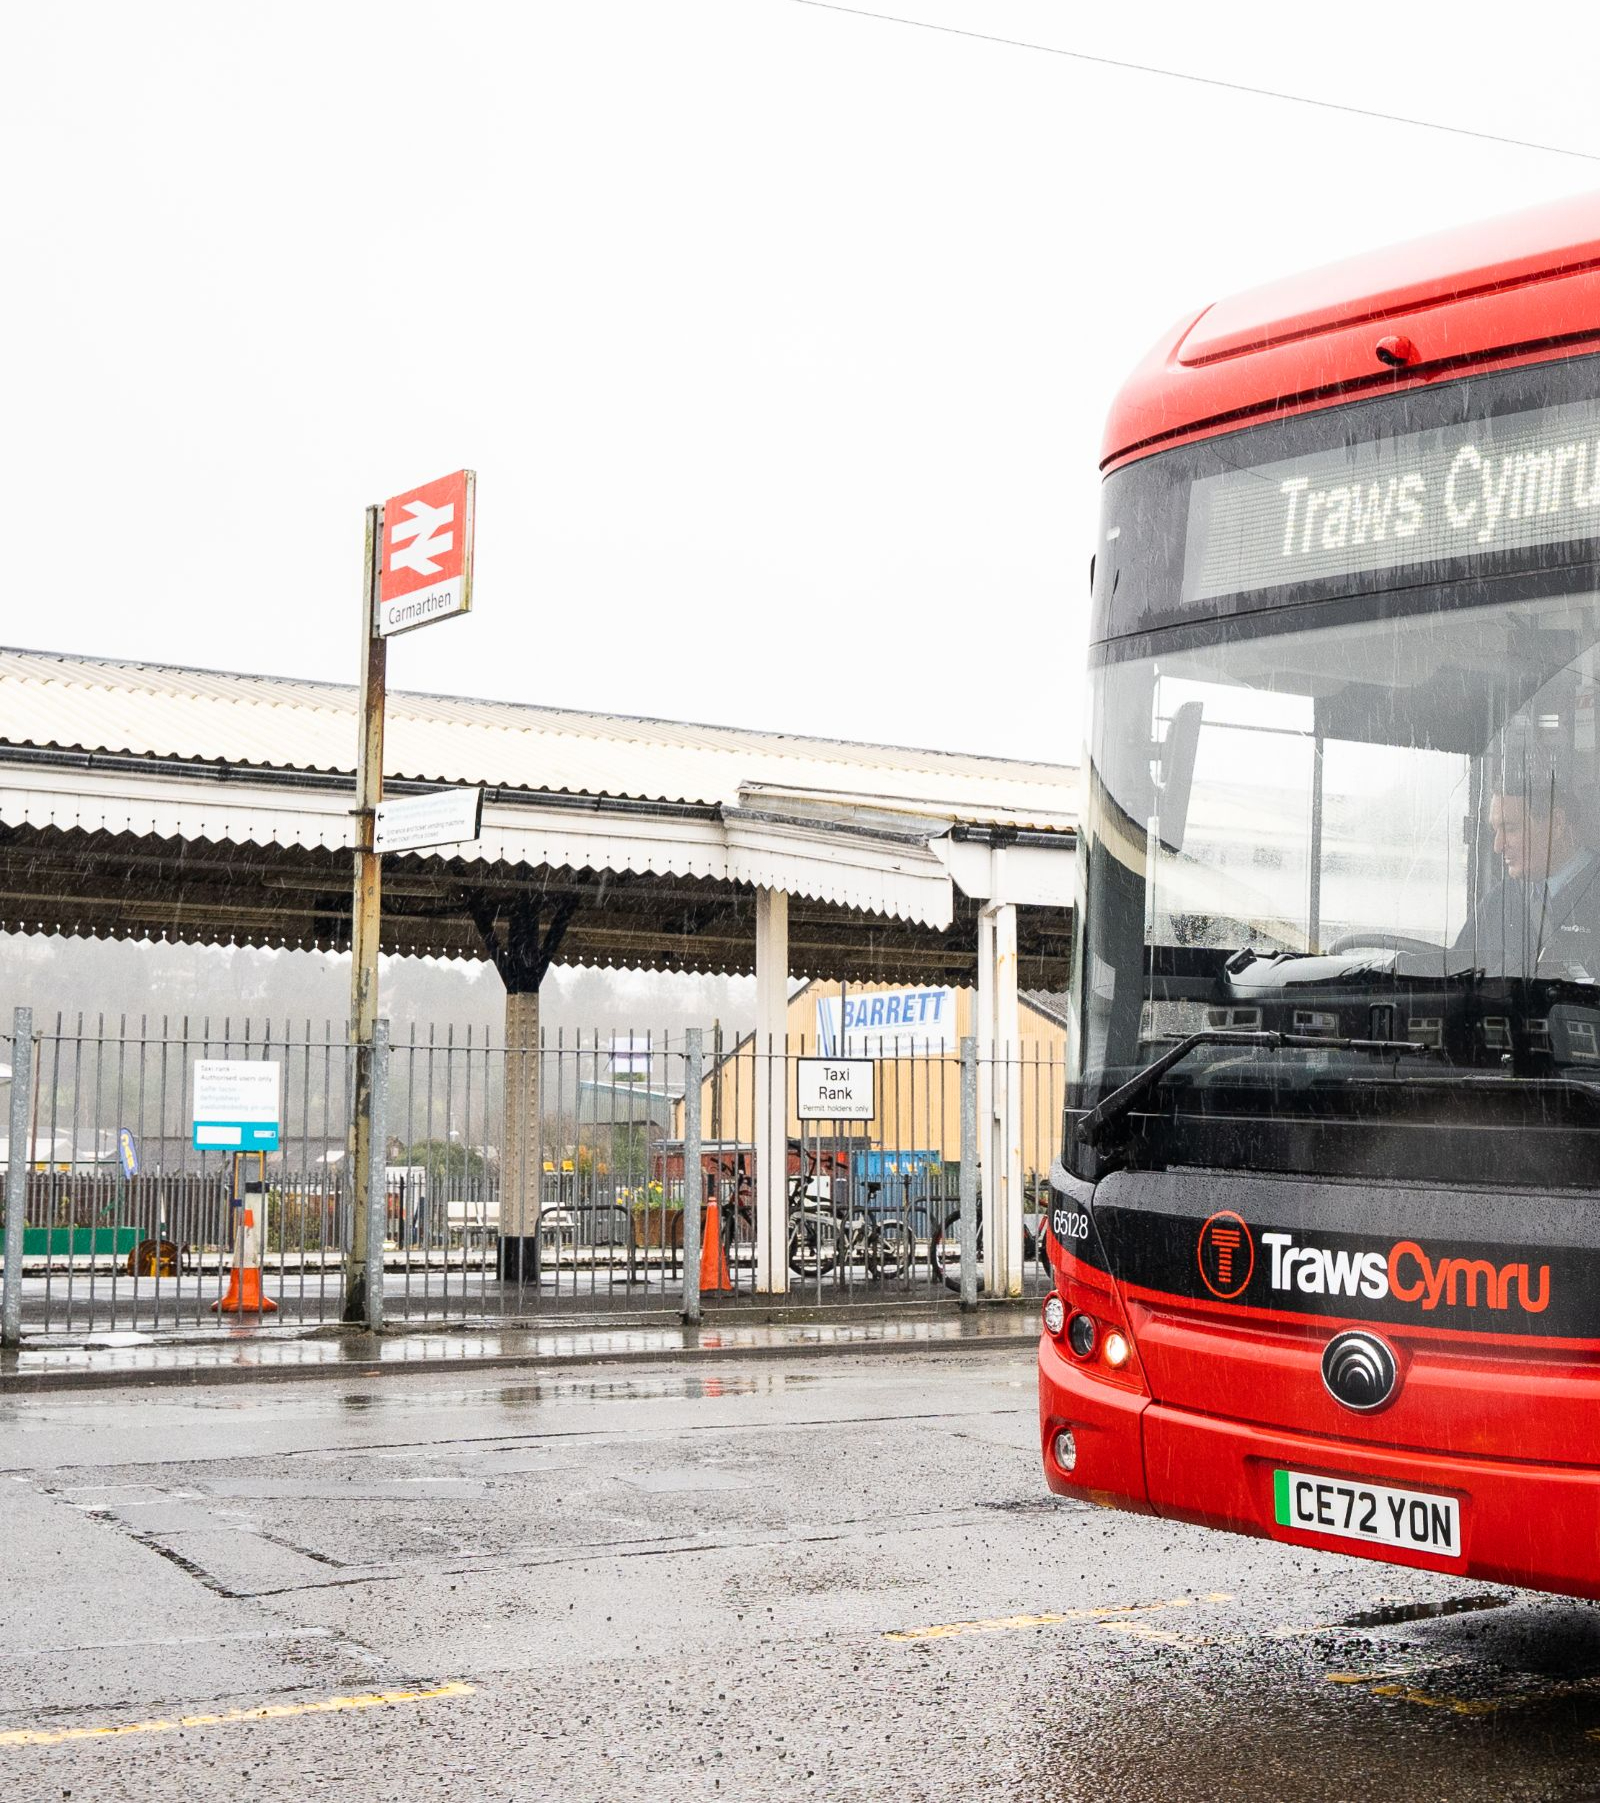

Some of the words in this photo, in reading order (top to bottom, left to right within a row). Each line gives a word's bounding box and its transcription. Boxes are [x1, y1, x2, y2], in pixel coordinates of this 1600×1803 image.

[1280, 470, 1426, 557] Traws
[388, 592, 452, 625] Carmarthen
[844, 990, 946, 1028] BARRETT
[823, 1067, 850, 1081] Taxi
[819, 1086, 853, 1100] Rank
[1052, 1209, 1090, 1240] 65128
[1261, 1232, 1551, 1313] TrawsCymru
[1295, 1480, 1378, 1535] CE72
[1387, 1495, 1453, 1548] YON
